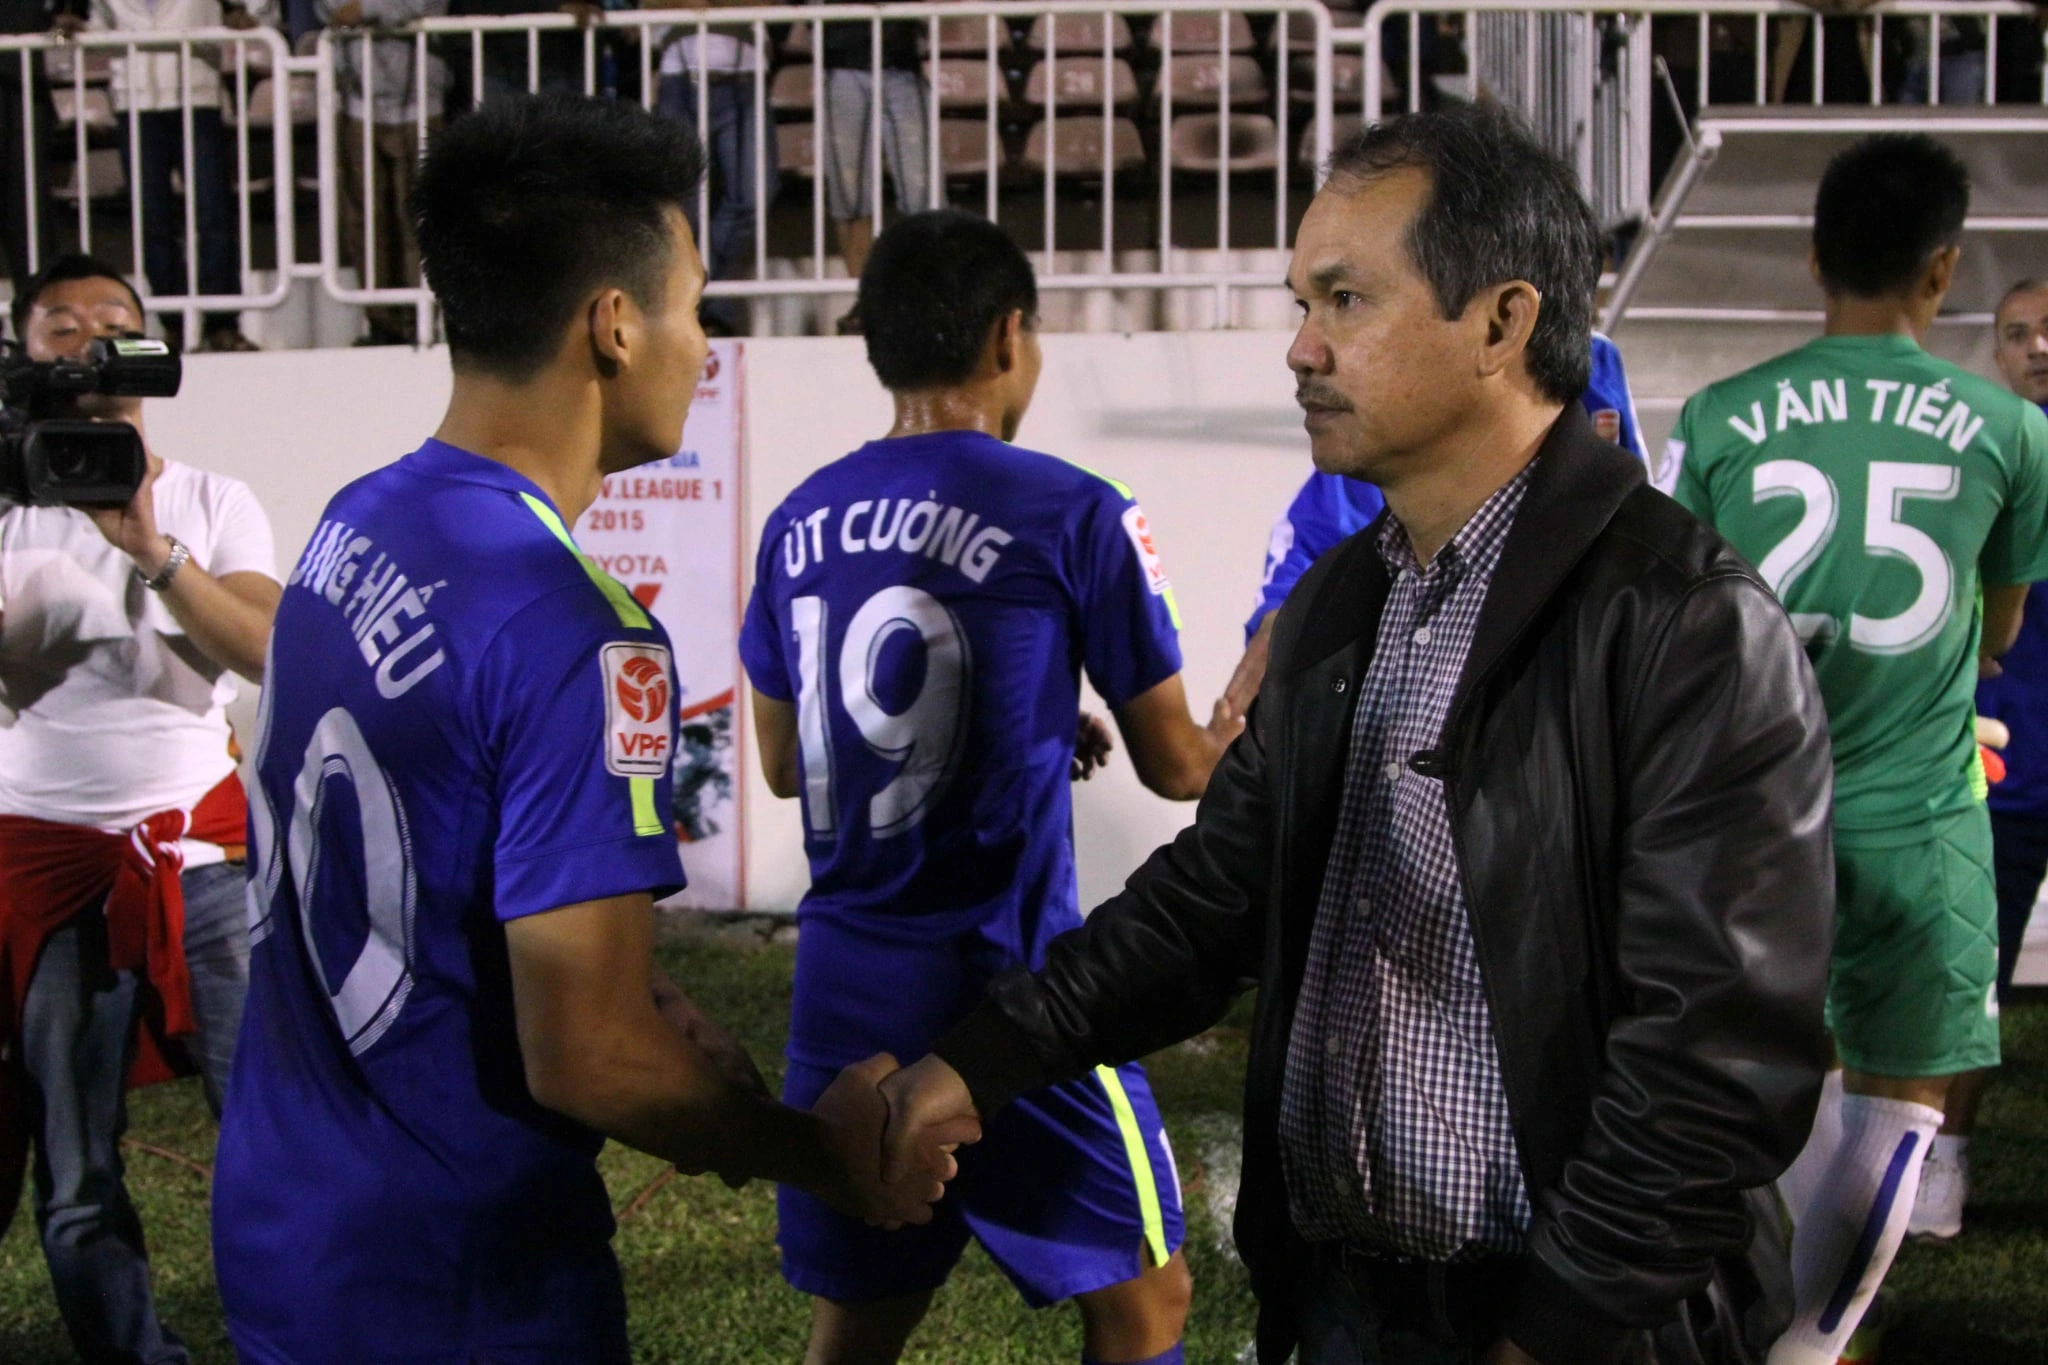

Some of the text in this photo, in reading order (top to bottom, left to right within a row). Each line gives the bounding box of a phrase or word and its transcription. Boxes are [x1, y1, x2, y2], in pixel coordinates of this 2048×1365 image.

[1728, 378, 1848, 446] VĂN
[713, 479, 723, 500] 1
[589, 509, 645, 531] 2015
[1753, 459, 1961, 656] 25
[791, 585, 972, 841] 19
[618, 731, 668, 758] VPF
